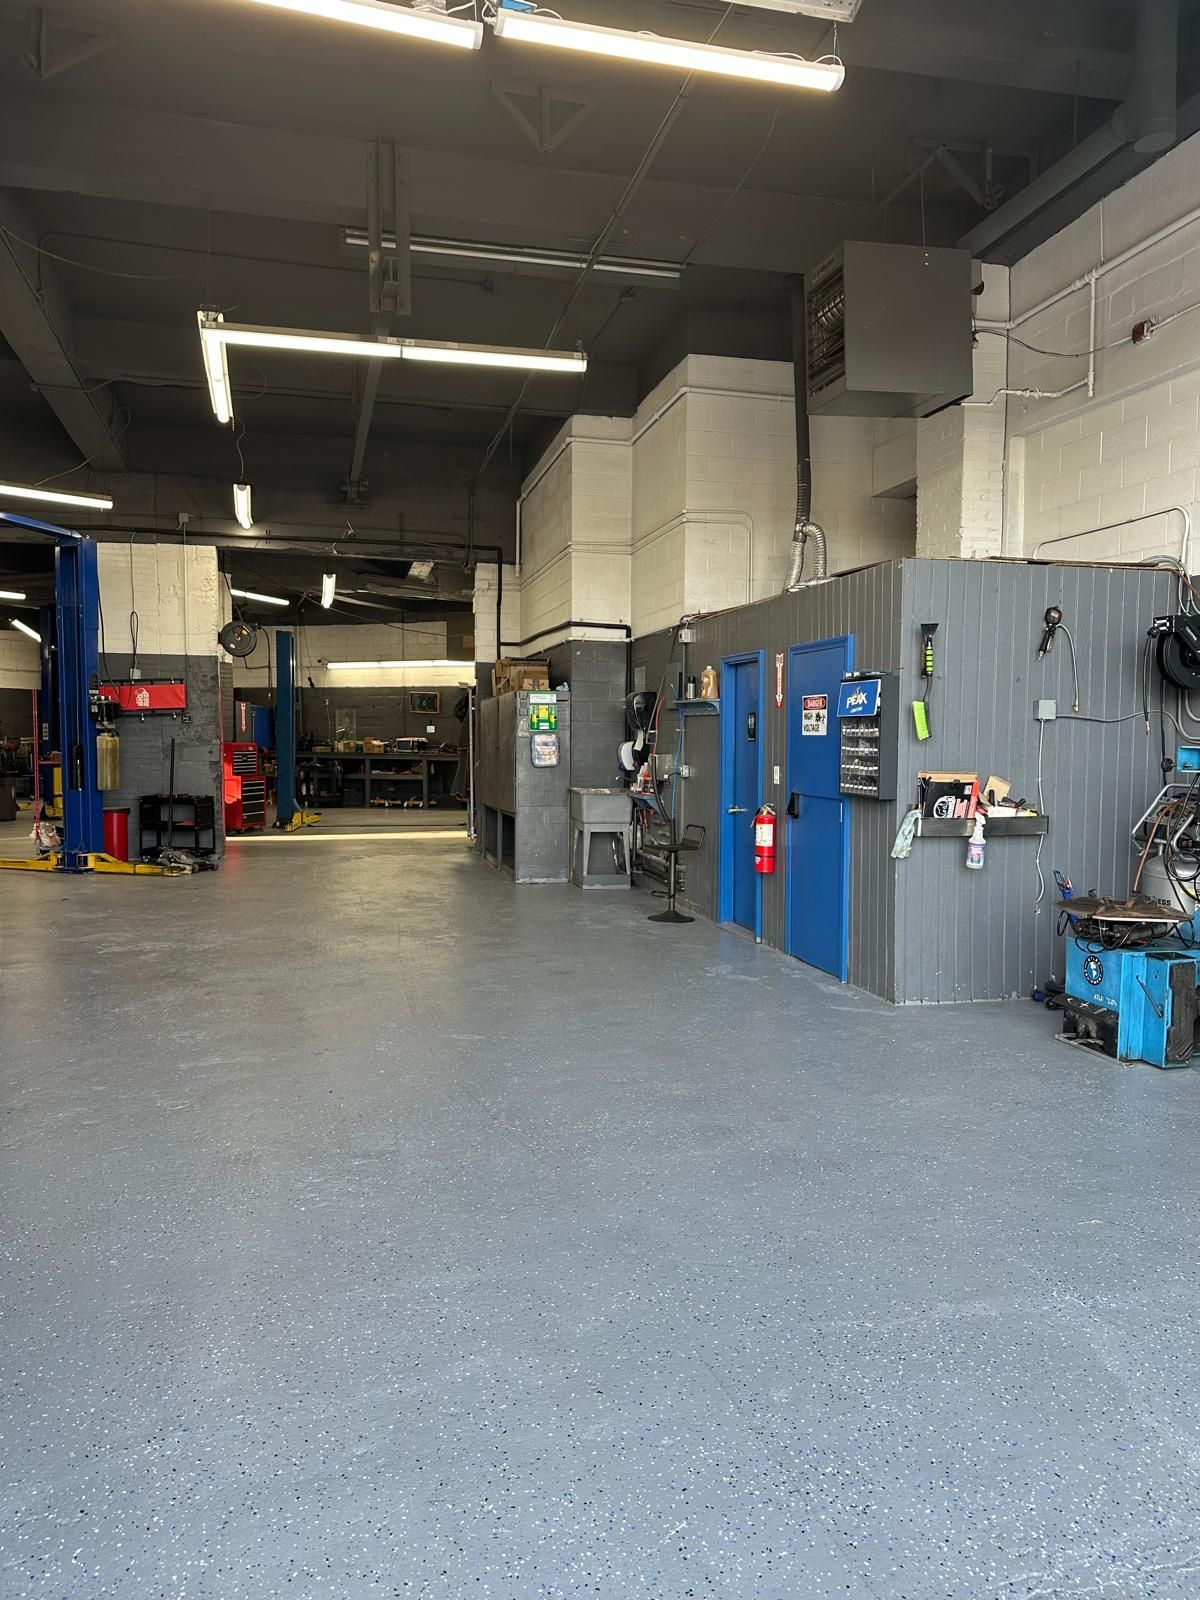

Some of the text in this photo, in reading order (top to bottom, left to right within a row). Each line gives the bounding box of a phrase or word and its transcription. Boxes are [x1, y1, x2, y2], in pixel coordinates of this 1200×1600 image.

[807, 699, 823, 708] DANGER
[846, 691, 868, 709] PEAK
[804, 724, 820, 732] VOLTAGE
